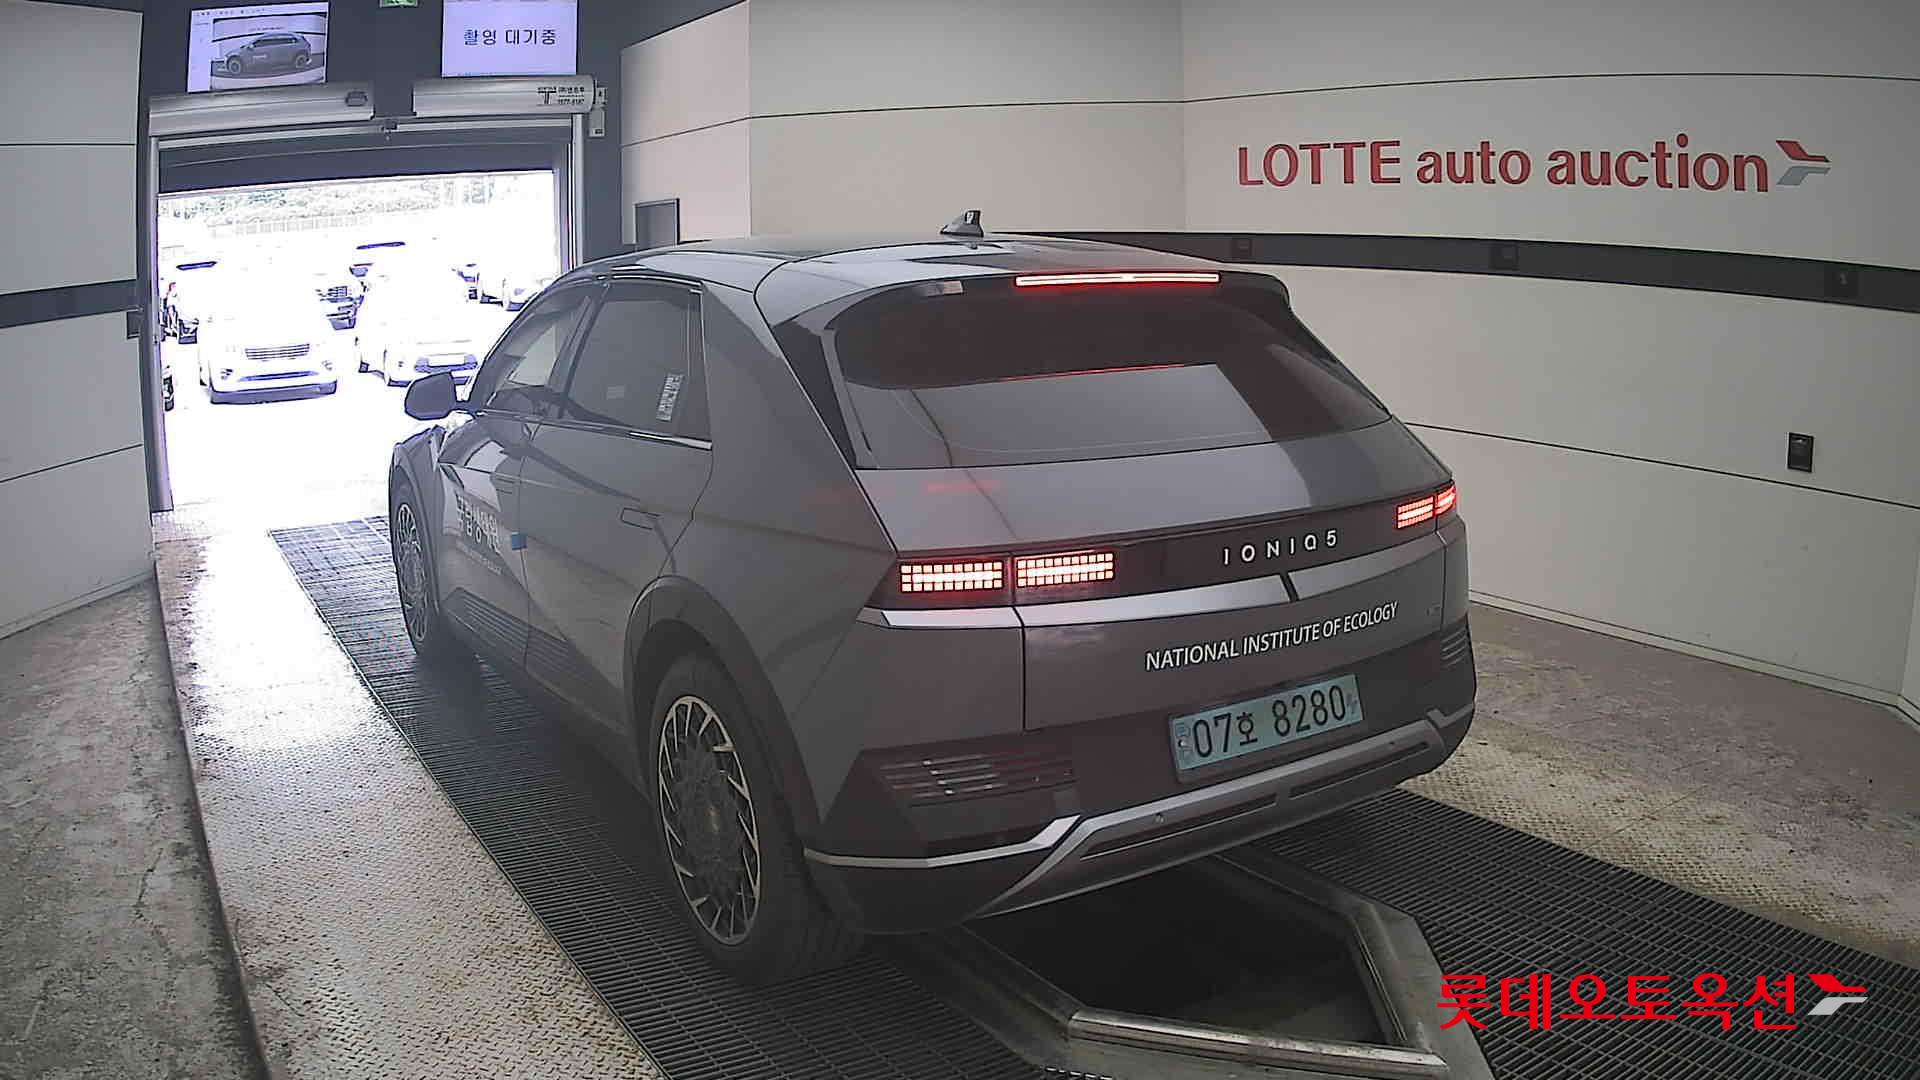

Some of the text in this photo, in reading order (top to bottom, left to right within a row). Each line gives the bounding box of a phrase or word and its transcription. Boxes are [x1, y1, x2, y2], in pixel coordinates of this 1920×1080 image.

[505, 28, 556, 46] 대기중
[1238, 132, 1769, 193] LOTTE auto auction
[1145, 601, 1399, 671] NATIONAL INSTITUTE OF ECOLOGY
[1192, 712, 1258, 758] 07호
[1271, 684, 1347, 738] 8280
